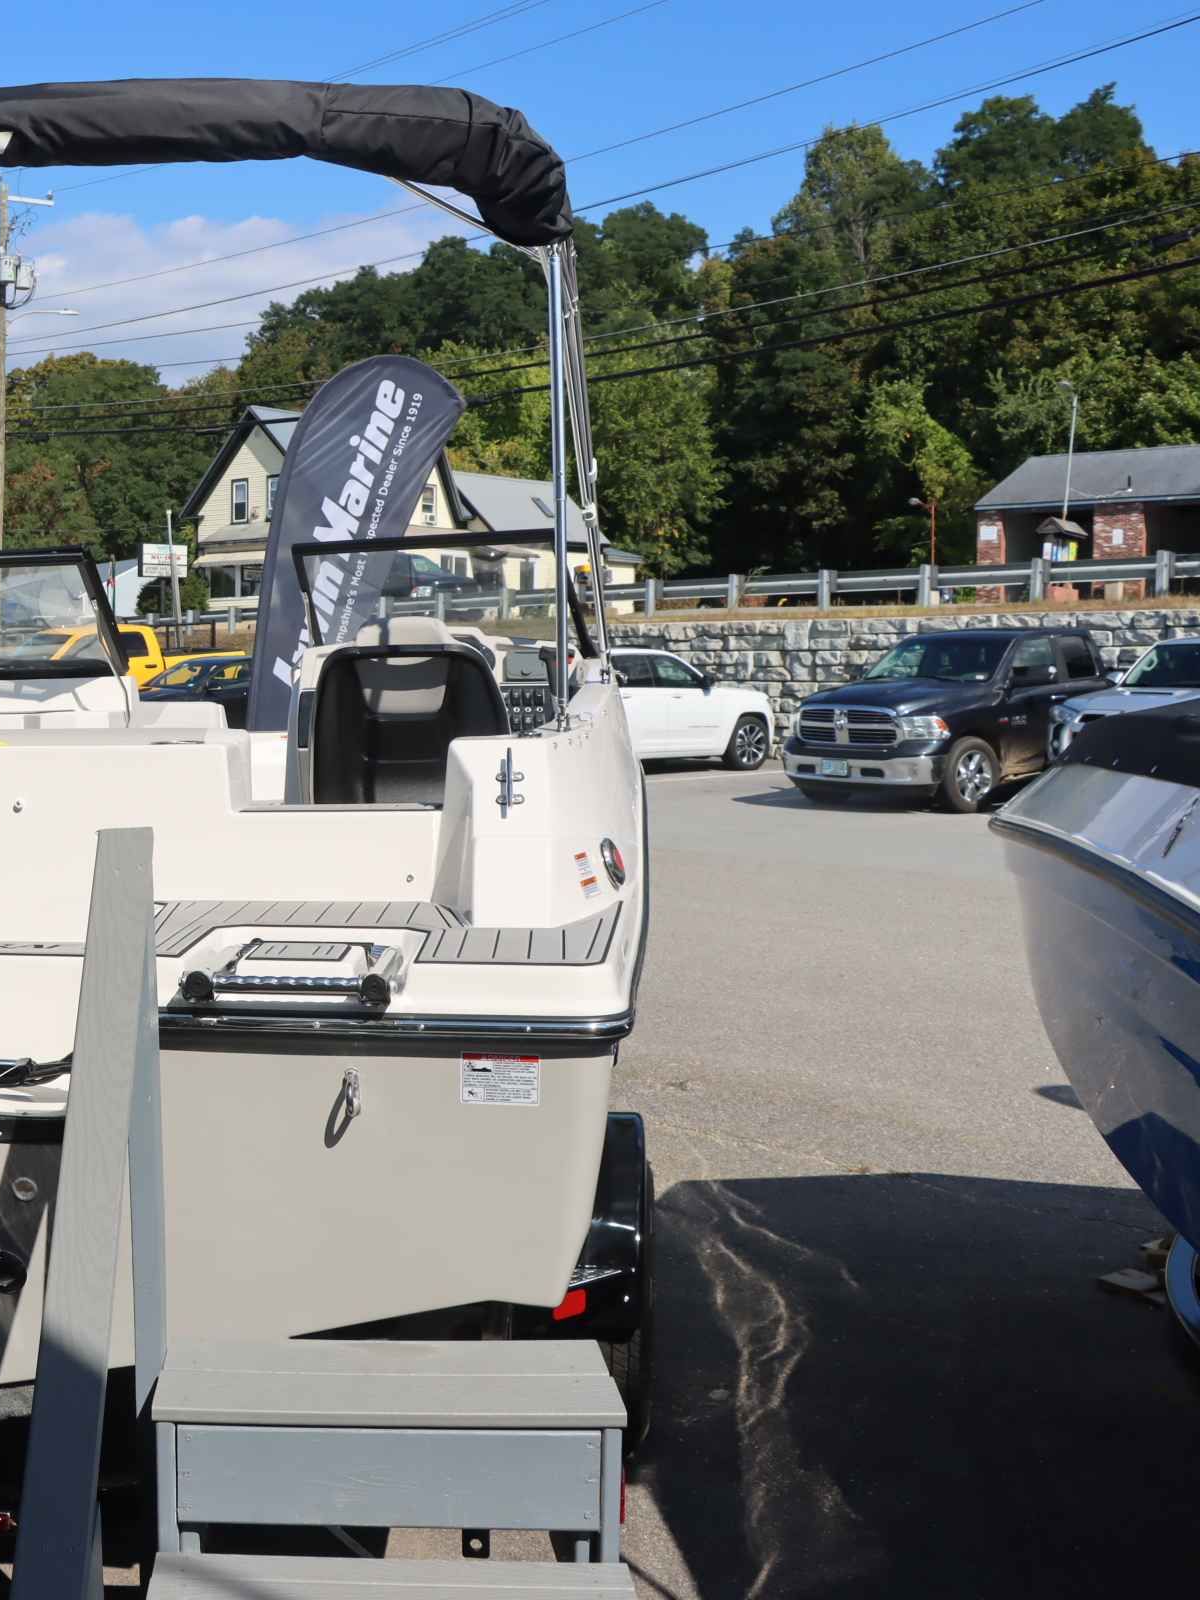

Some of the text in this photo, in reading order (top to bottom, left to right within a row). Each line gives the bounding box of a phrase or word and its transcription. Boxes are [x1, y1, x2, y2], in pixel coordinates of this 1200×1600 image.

[313, 379, 405, 561] Marine
[335, 590, 358, 643] mpshire's
[350, 559, 367, 586] Most
[378, 458, 399, 497] Dealer
[392, 425, 412, 457] Since
[406, 393, 423, 423] 1919
